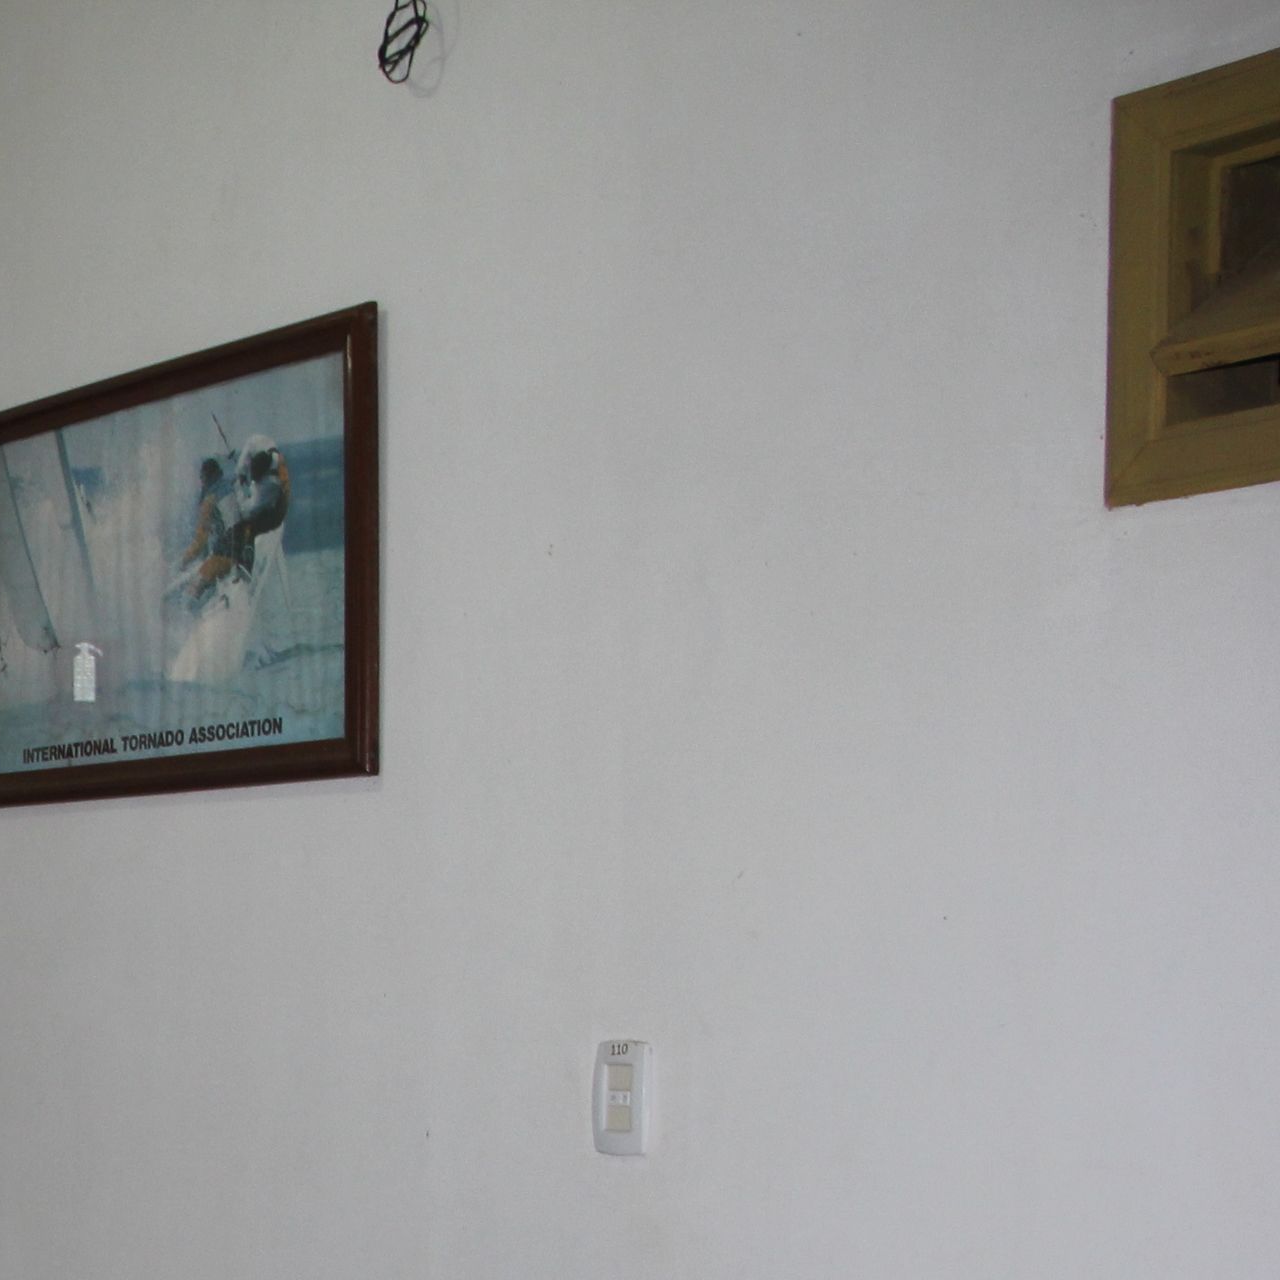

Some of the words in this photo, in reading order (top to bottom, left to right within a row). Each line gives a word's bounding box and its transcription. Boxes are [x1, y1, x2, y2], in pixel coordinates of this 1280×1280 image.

[23, 738, 117, 764] INTERNATIONAL
[121, 729, 185, 752] TORNADO
[189, 717, 283, 745] ASSOCIATION
[610, 1043, 629, 1056] 110
